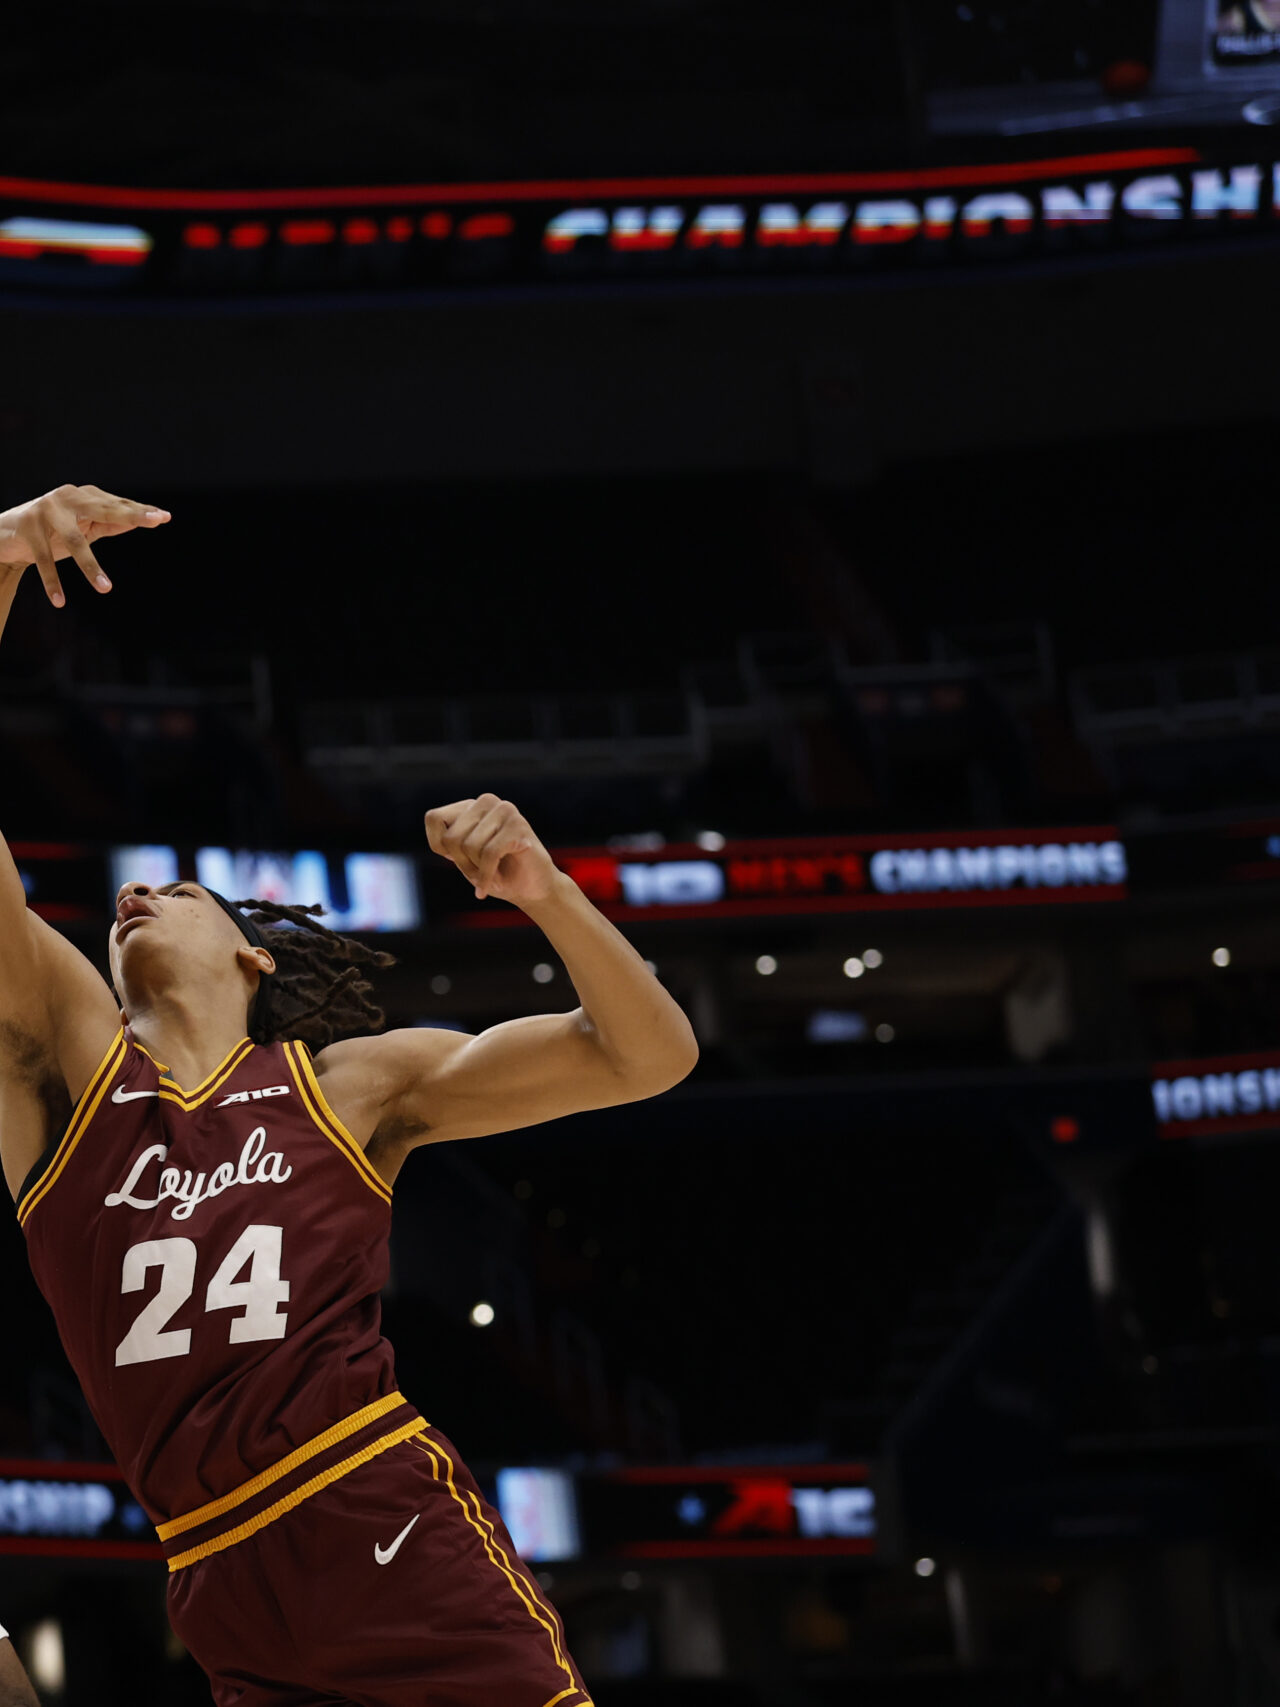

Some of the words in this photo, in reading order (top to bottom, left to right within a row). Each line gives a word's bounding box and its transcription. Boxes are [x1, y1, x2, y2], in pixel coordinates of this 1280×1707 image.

[216, 1085, 291, 1107] A10
[105, 1127, 292, 1220] Loyola
[115, 1225, 290, 1367] 24
